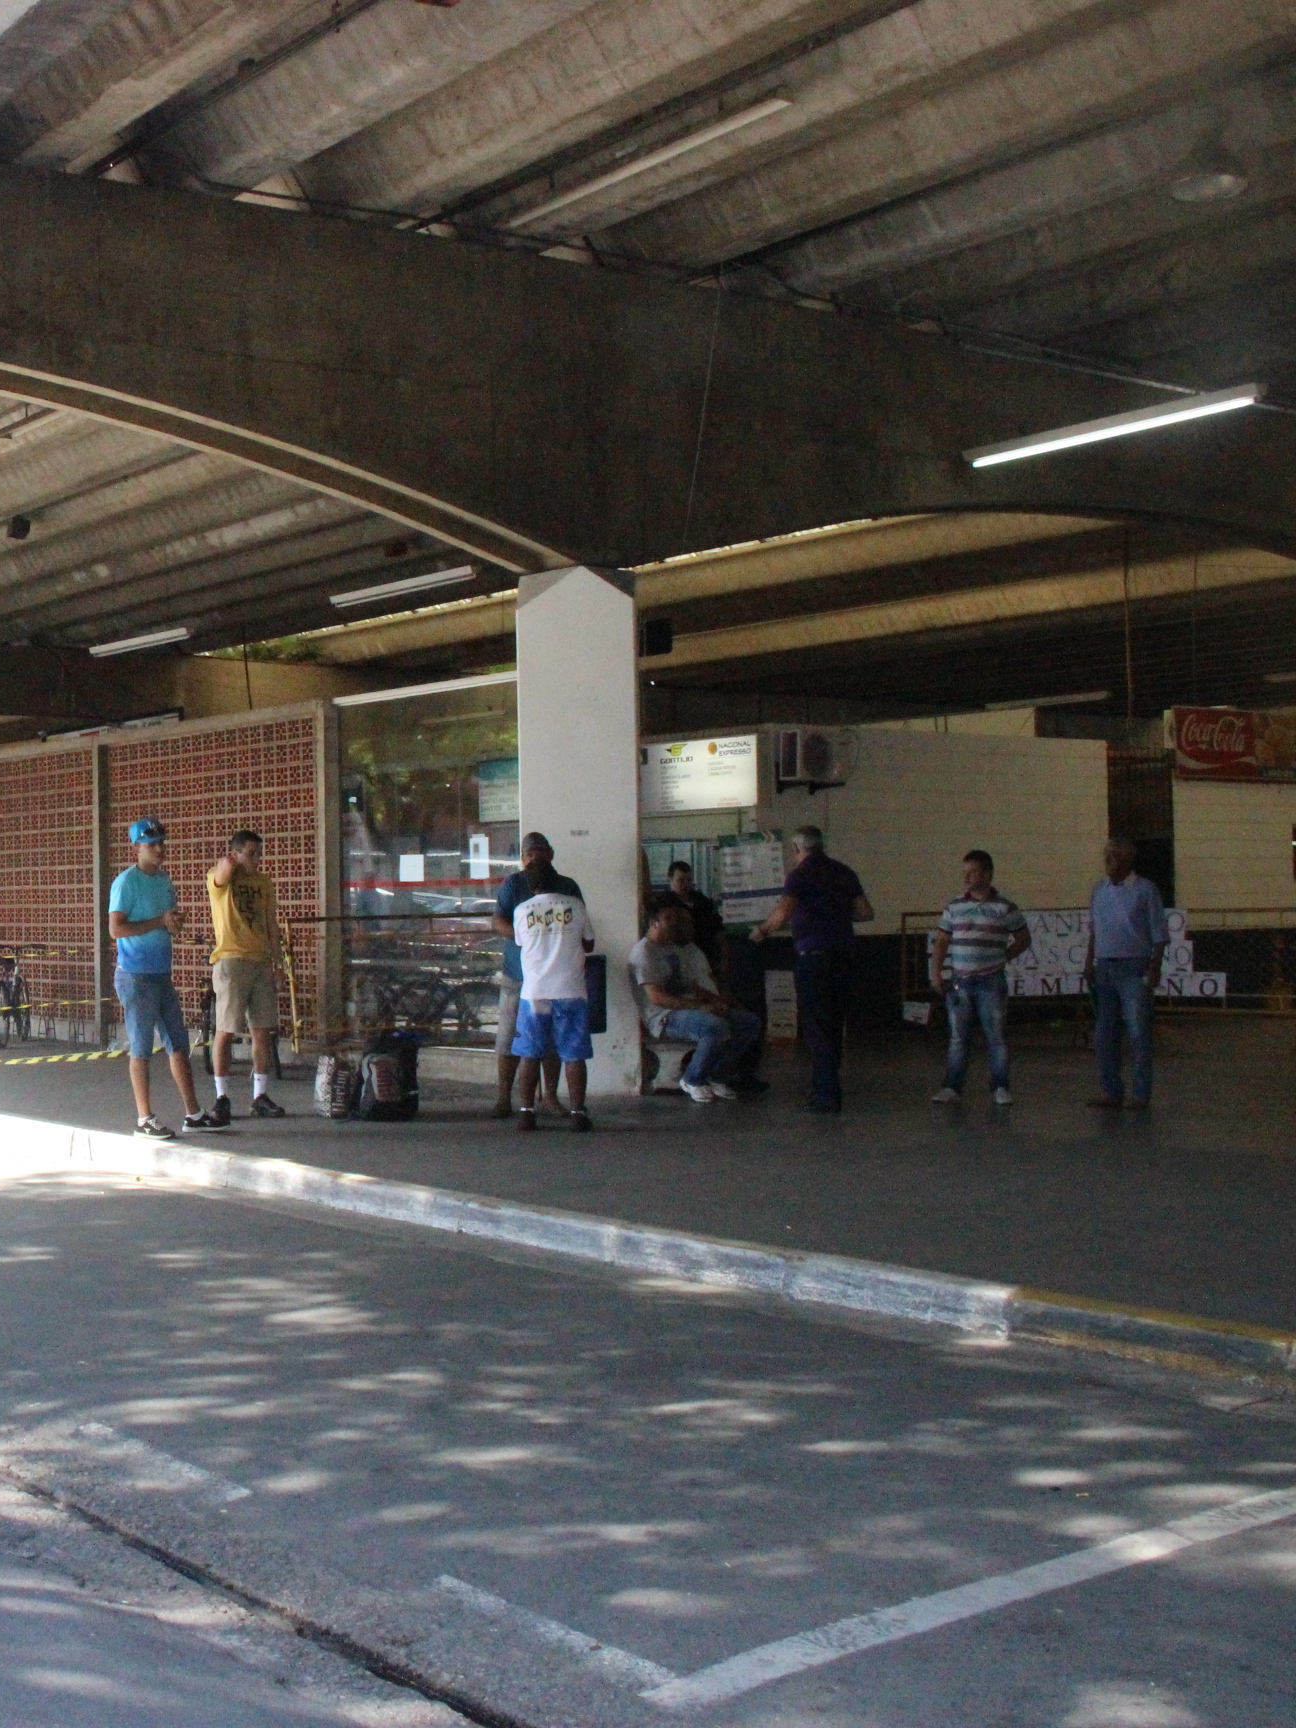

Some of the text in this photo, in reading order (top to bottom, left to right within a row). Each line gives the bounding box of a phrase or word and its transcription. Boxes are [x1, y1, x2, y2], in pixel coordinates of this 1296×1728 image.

[718, 740, 751, 749] NACIONAL
[718, 748, 752, 757] EXPRESSO
[660, 756, 693, 765] GONTIJO
